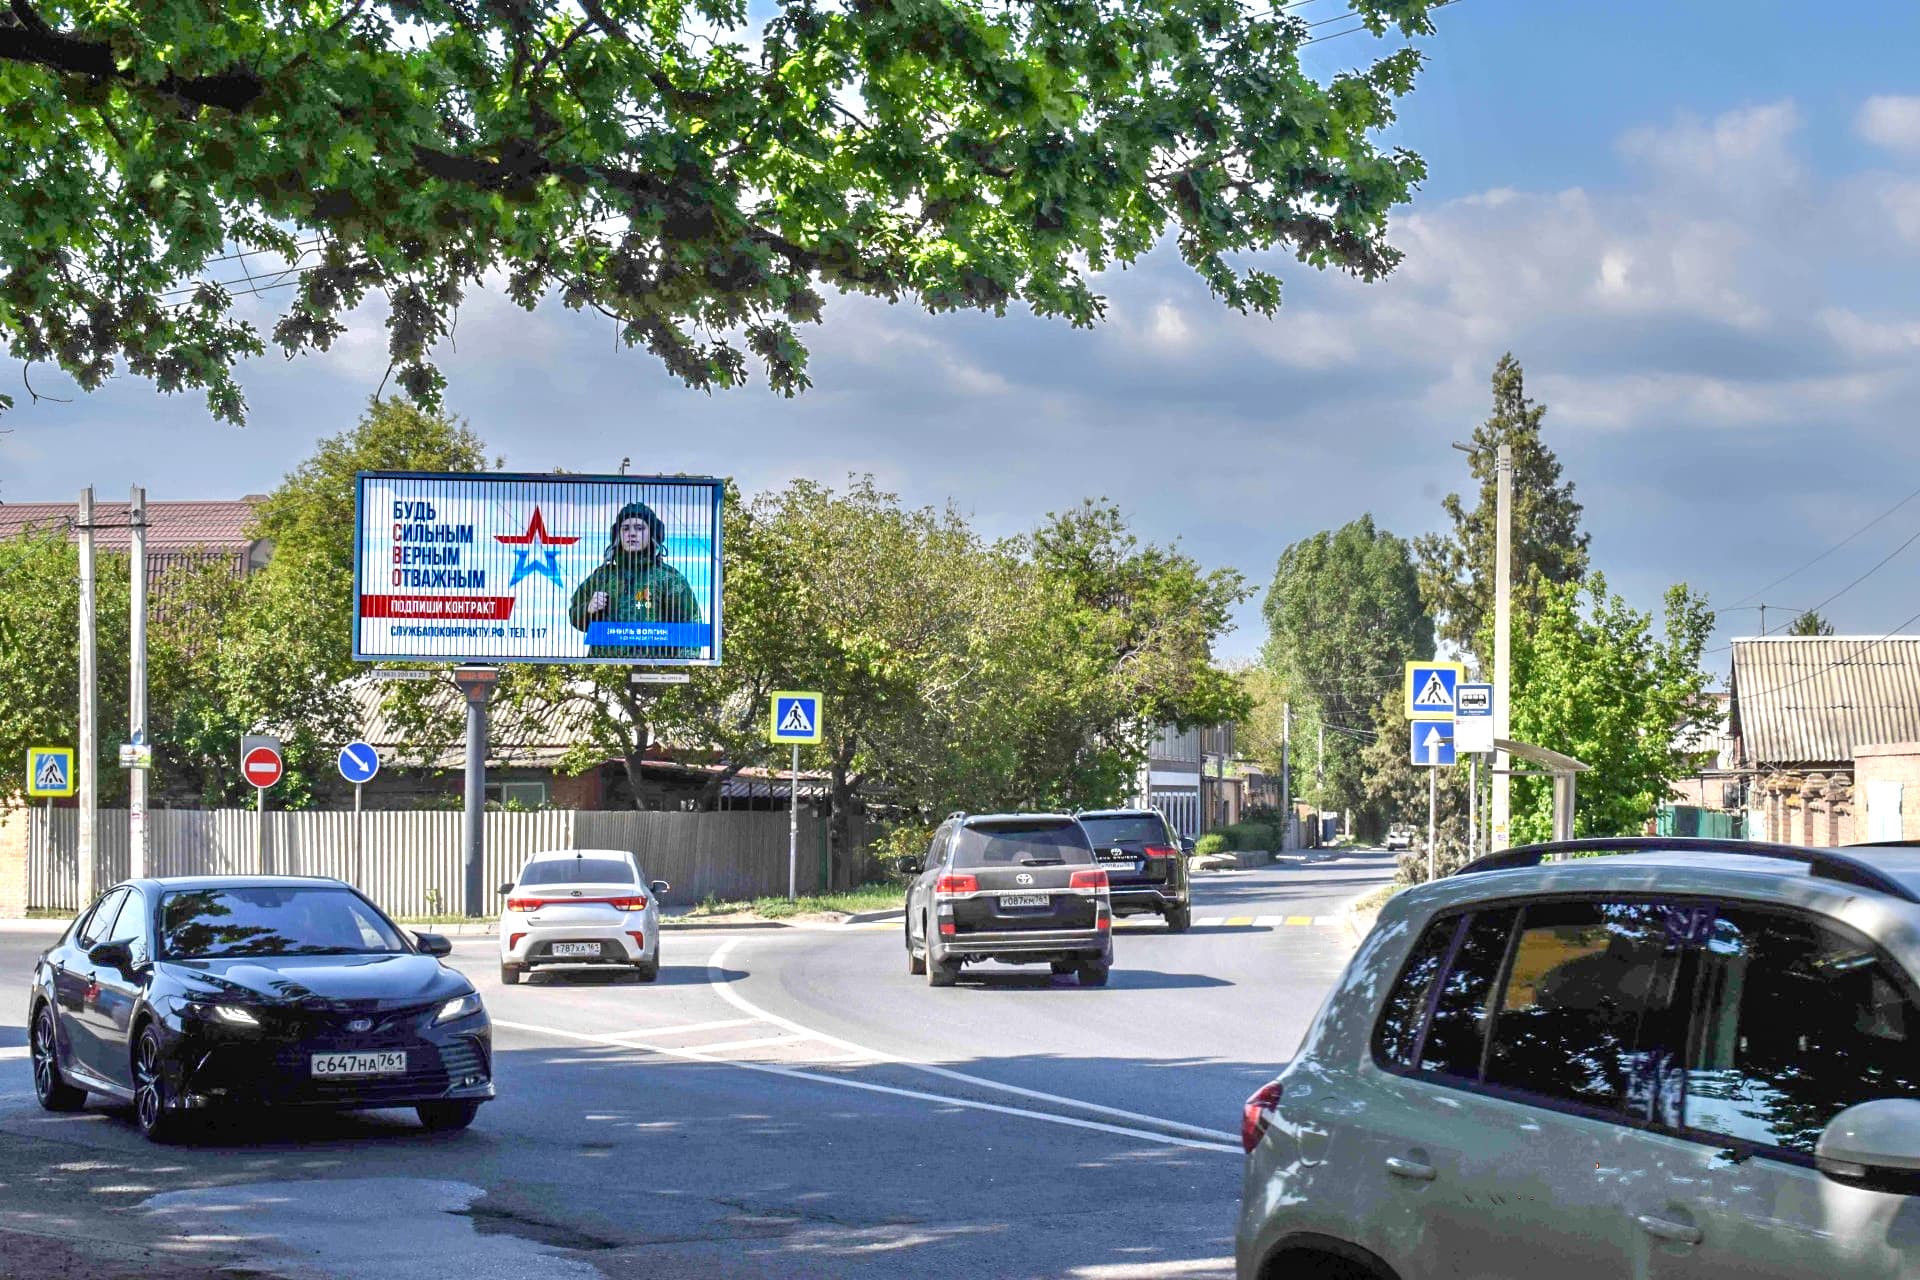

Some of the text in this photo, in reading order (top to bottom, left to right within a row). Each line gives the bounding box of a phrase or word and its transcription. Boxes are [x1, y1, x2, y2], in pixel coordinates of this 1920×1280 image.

[394, 501, 436, 522] БУДЬ
[393, 523, 473, 543] СИЛЬНЫМ
[392, 546, 460, 565] ВЕРНЫМ
[392, 568, 485, 588] ОТВАЖНЫМ
[390, 600, 496, 614] ПОДПИШИ КОНТРАКТ
[531, 628, 547, 638] 117
[316, 1054, 403, 1073] С647НА 761
